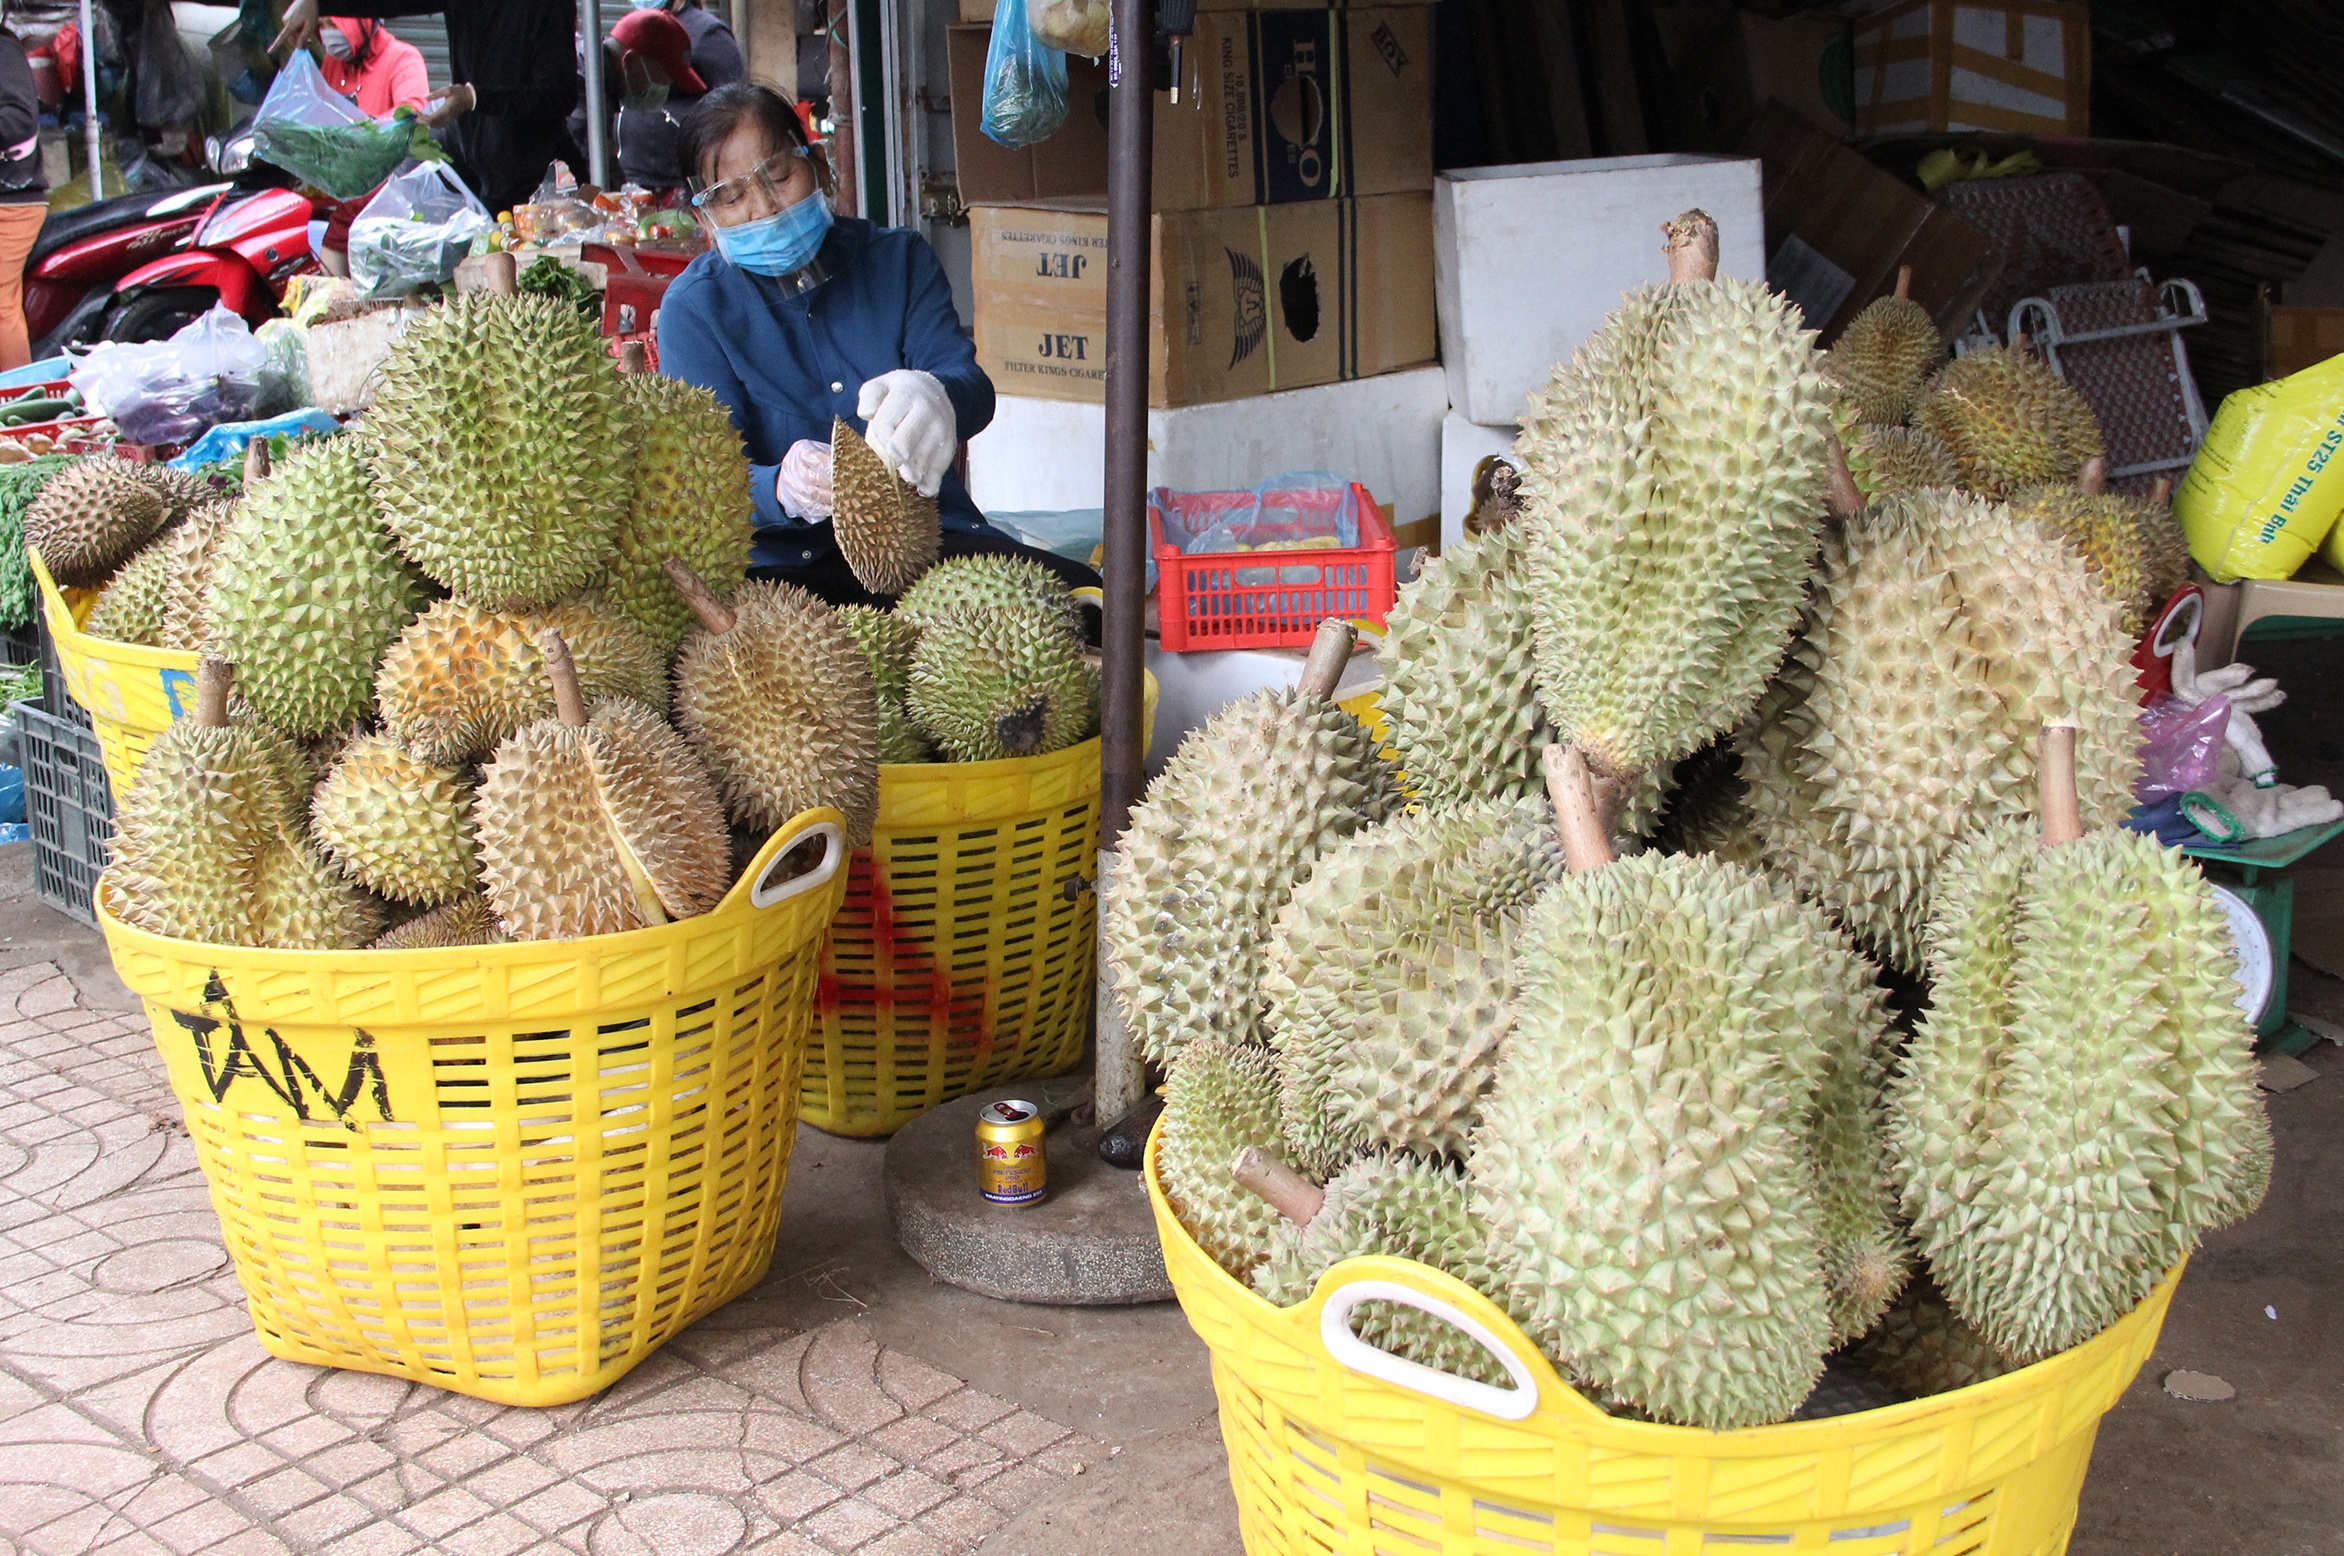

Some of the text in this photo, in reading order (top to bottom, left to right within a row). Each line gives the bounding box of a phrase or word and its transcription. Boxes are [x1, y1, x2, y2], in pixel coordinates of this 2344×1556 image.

[1221, 36, 1240, 179] KING SIZE CIGARETTES
[1036, 252, 1088, 280] JET
[1038, 333, 1090, 361] JET
[1005, 361, 1036, 374] FILTER
[1037, 364, 1068, 377] KINGS
[2306, 429, 2343, 474] ST25
[2278, 475, 2315, 514] Thái
